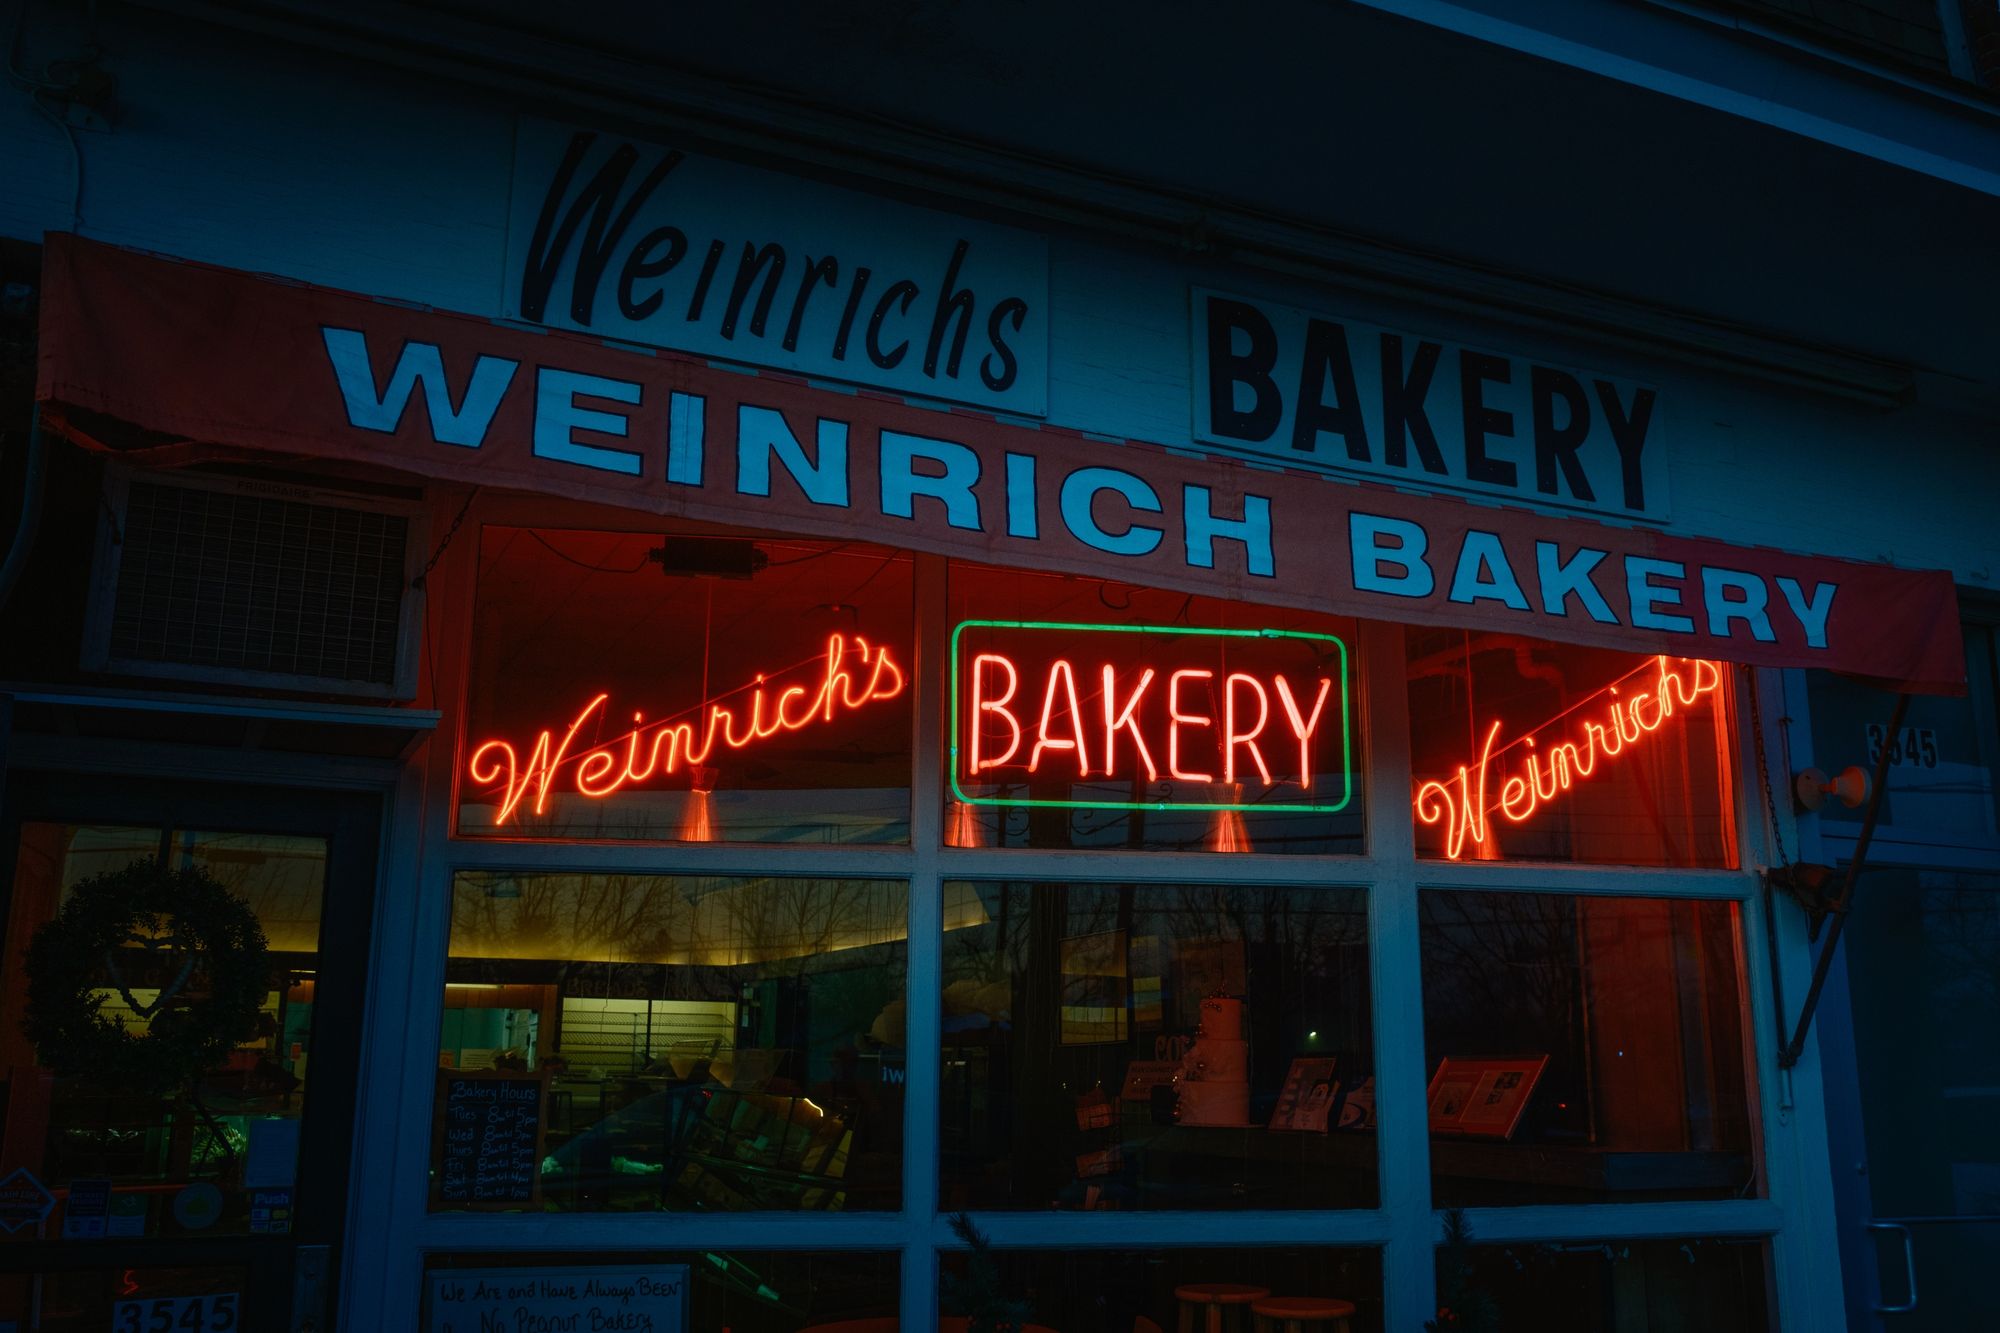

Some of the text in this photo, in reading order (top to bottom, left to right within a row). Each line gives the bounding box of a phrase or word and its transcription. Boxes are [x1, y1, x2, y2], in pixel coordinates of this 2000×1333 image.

[520, 131, 1028, 392] Weinrichs
[319, 324, 1840, 650] WEINRICH BAKERY
[1207, 297, 1657, 512] BAKERY
[471, 632, 903, 826] Weinrich's
[970, 653, 1332, 790] BAKERY
[1417, 654, 1720, 860] Weinrichs
[448, 1128, 474, 1141] Wed
[450, 1081, 537, 1104] Bakery Hours
[119, 1295, 235, 1333] 3545
[441, 1281, 465, 1302] We
